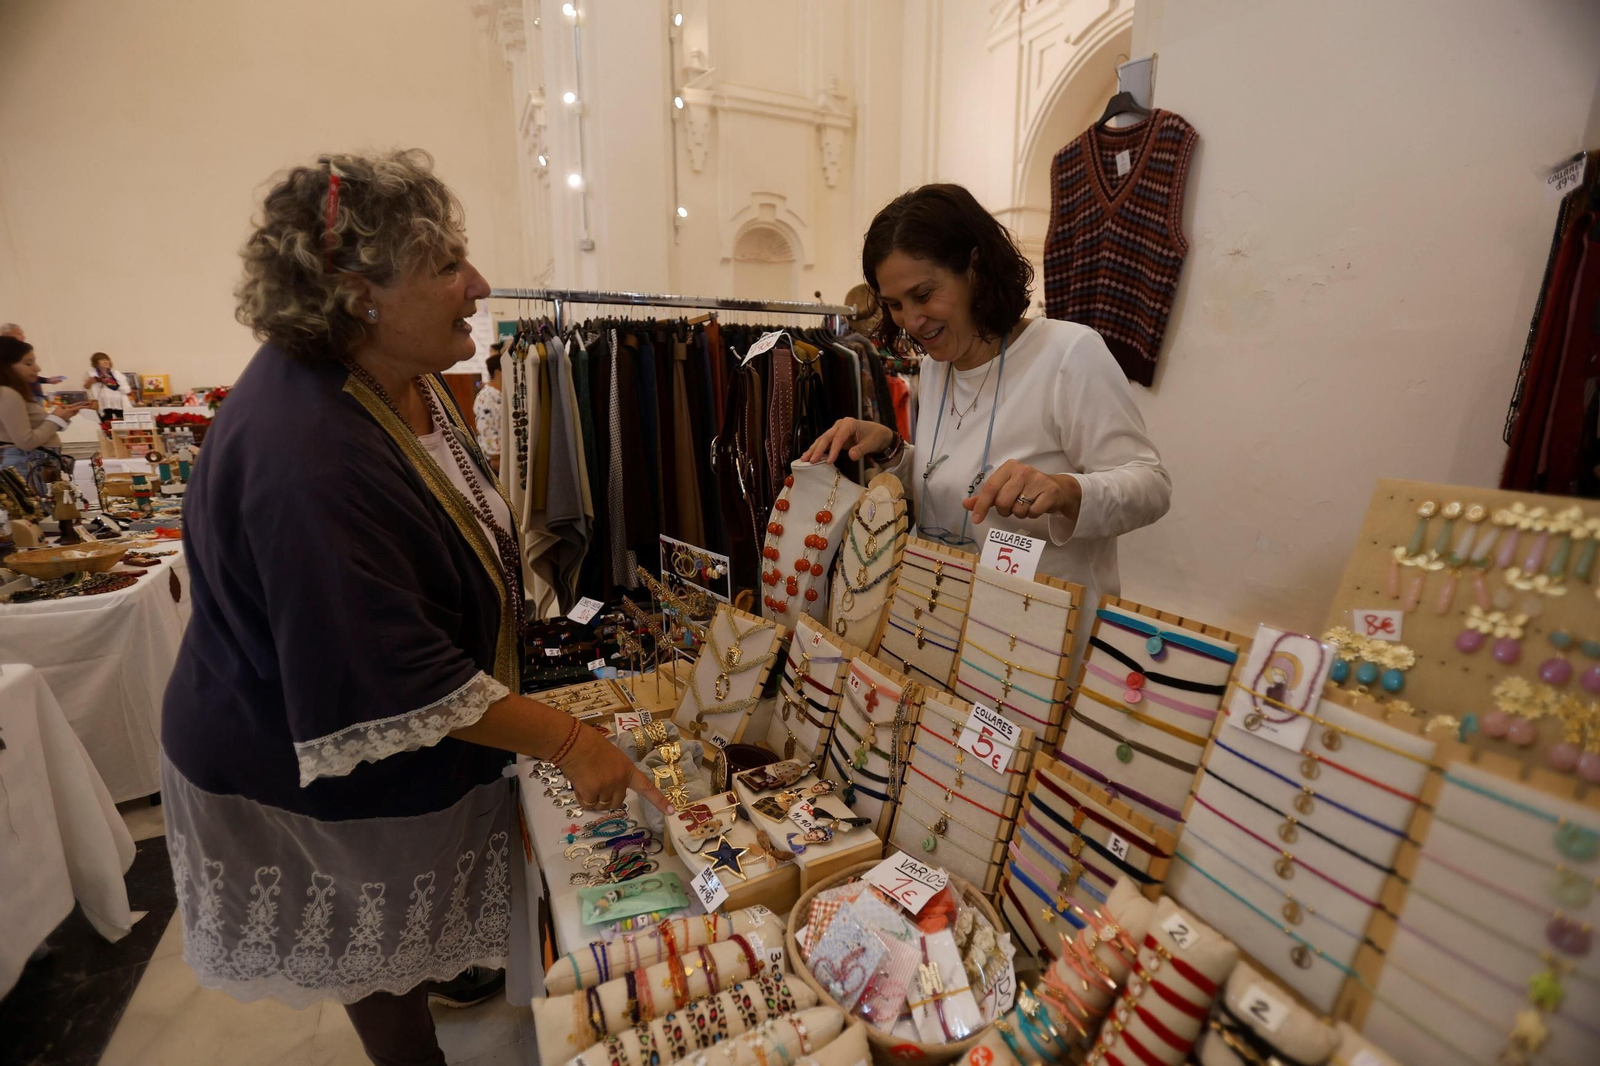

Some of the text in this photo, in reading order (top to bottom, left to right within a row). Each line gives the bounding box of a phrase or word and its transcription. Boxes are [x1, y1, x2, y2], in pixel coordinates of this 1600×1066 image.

[990, 530, 1033, 549] COLLARES
[975, 706, 1014, 735] COLLARES
[971, 726, 1002, 770] 5€
[1111, 837, 1125, 858] 5€
[900, 858, 947, 888] VARIOS
[878, 877, 918, 906] 1€
[1168, 923, 1190, 945] 2€
[770, 951, 782, 974] 3€
[1249, 999, 1271, 1025] 2
